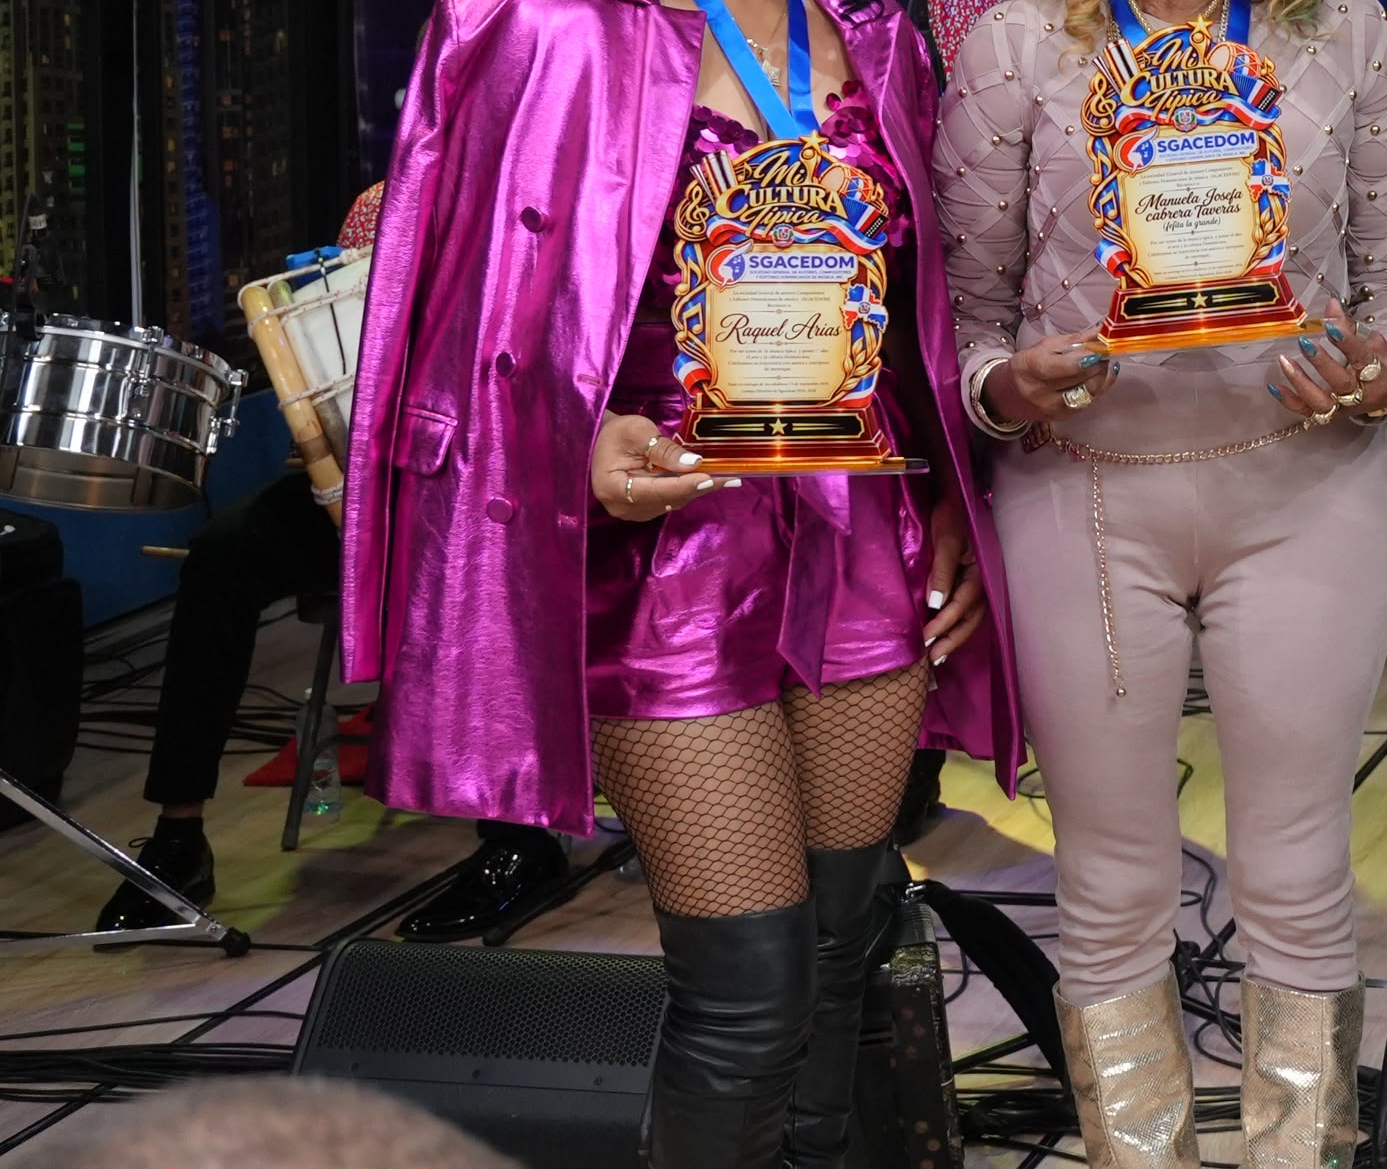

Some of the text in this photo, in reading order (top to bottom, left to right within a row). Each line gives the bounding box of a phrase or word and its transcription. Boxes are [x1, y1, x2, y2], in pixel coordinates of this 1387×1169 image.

[1152, 38, 1198, 73] Mi
[1120, 68, 1240, 106] CULTURA
[1157, 132, 1255, 153] SGACEDOM
[753, 150, 806, 187] Mi
[716, 184, 848, 219] CULTURA
[1135, 187, 1243, 214] Manuela Josefa
[1145, 203, 1241, 223] cabrera Taveras
[749, 255, 855, 269] SGACEDOM
[715, 312, 841, 344] Raquel Arias
